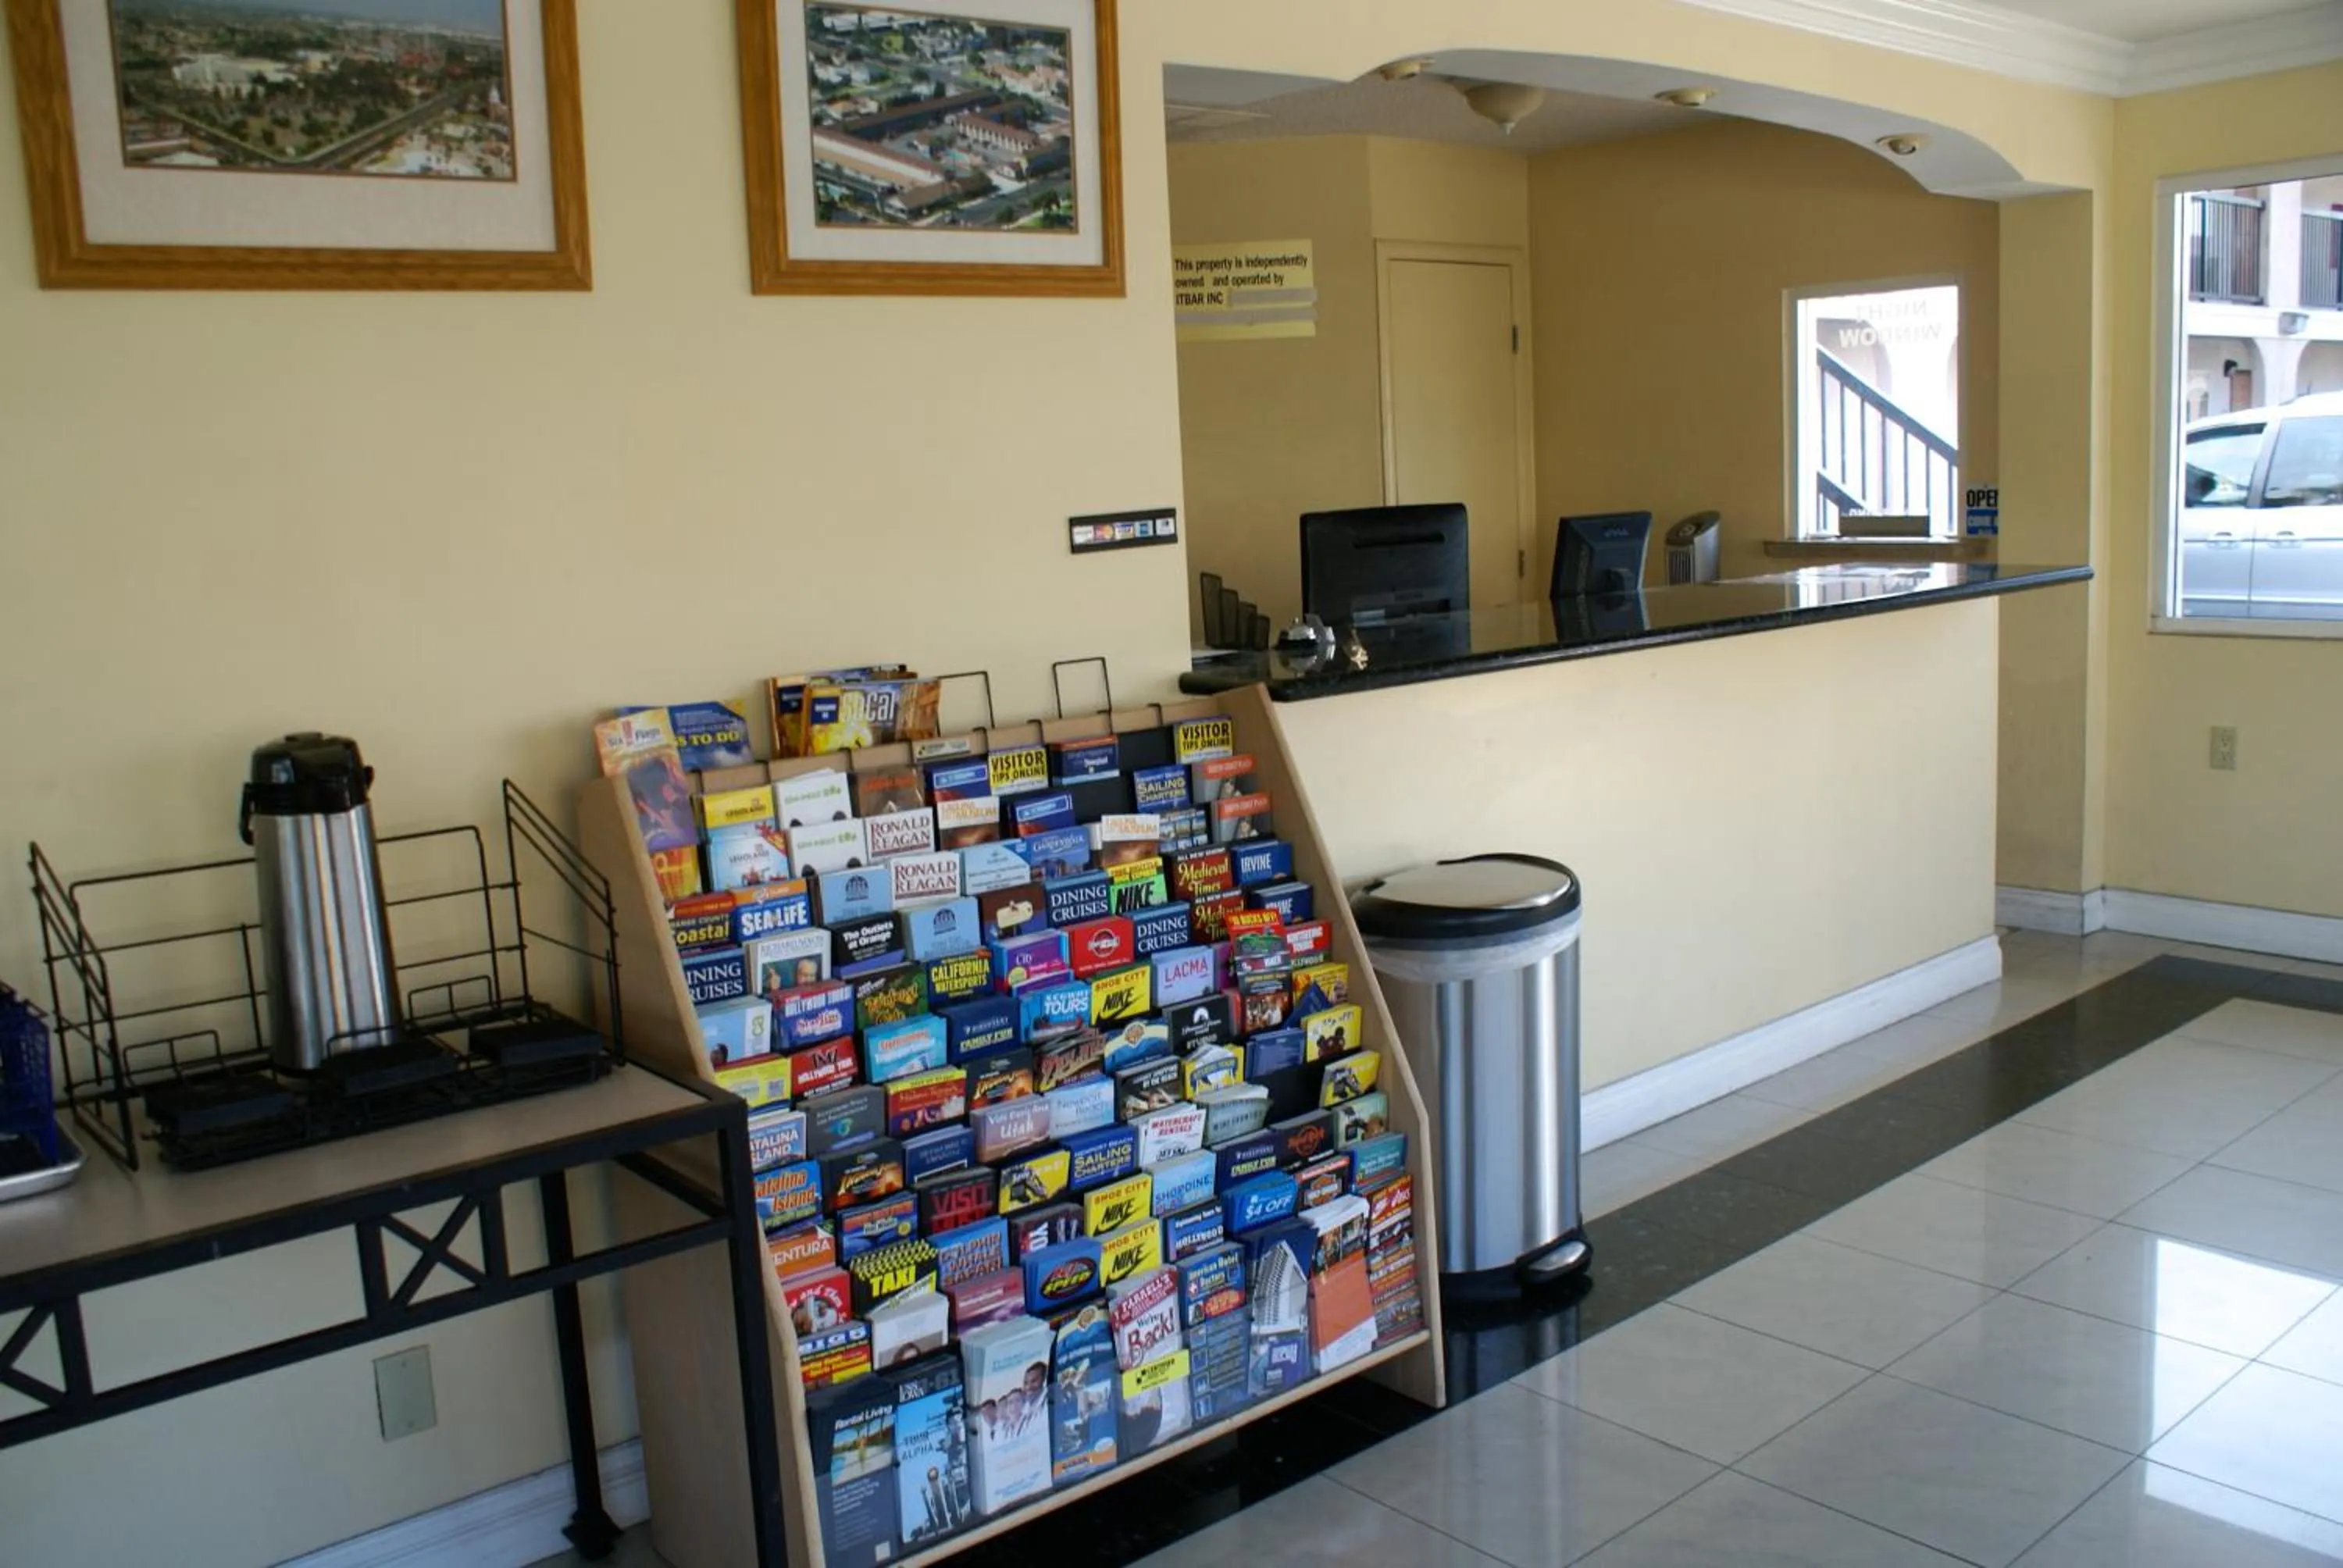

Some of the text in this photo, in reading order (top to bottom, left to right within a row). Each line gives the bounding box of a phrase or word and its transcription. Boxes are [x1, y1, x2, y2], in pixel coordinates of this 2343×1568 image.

[1174, 254, 1307, 273] This property is independently
[1175, 273, 1284, 288] owned and operated by
[1207, 290, 1224, 304] INC
[690, 733, 713, 747] TO
[716, 730, 740, 745] DO
[1182, 722, 1230, 740] VISITOR
[1182, 735, 1230, 750] TIPS ONLINE
[990, 750, 1044, 772] VISITOR
[991, 764, 1045, 784] TIPS ONLINE
[1137, 777, 1186, 794] SAILING
[871, 816, 930, 839] RONALD
[872, 830, 930, 851] REAGAN
[894, 861, 958, 882] RONALD
[1178, 858, 1229, 886] Medieval
[1241, 852, 1271, 874] IRVINE
[895, 874, 958, 895] REAGAN
[1051, 884, 1107, 907] DINING
[1115, 881, 1155, 914] NIKE
[1052, 900, 1109, 923] CRUISES
[843, 920, 893, 942] The Outlets
[1137, 914, 1189, 938] DINING
[847, 930, 892, 950] at Orange
[1138, 931, 1189, 953] CRUISES
[686, 962, 742, 985] INING
[931, 958, 991, 983] CALIFORNIA
[1095, 970, 1147, 992] SHOE CITY
[1164, 956, 1209, 984] LACMA
[690, 979, 743, 1002] RUISES
[1102, 986, 1135, 1013] NIKE
[1043, 997, 1089, 1015] TOURS
[749, 1128, 800, 1151] ATALINA
[750, 1143, 792, 1163] SLAND
[1074, 1144, 1132, 1168] SAILING
[1074, 1154, 1132, 1178] CHARTERS
[1094, 1180, 1150, 1204] SHOE CITY
[1265, 1195, 1293, 1211] OFF
[1101, 1199, 1136, 1225] NIKE
[1102, 1226, 1157, 1253] SHOE CITY
[772, 1239, 831, 1265] ENTURA
[1112, 1244, 1145, 1272] NIKE
[869, 1265, 916, 1298] TAXI
[1127, 1307, 1175, 1354] Back!
